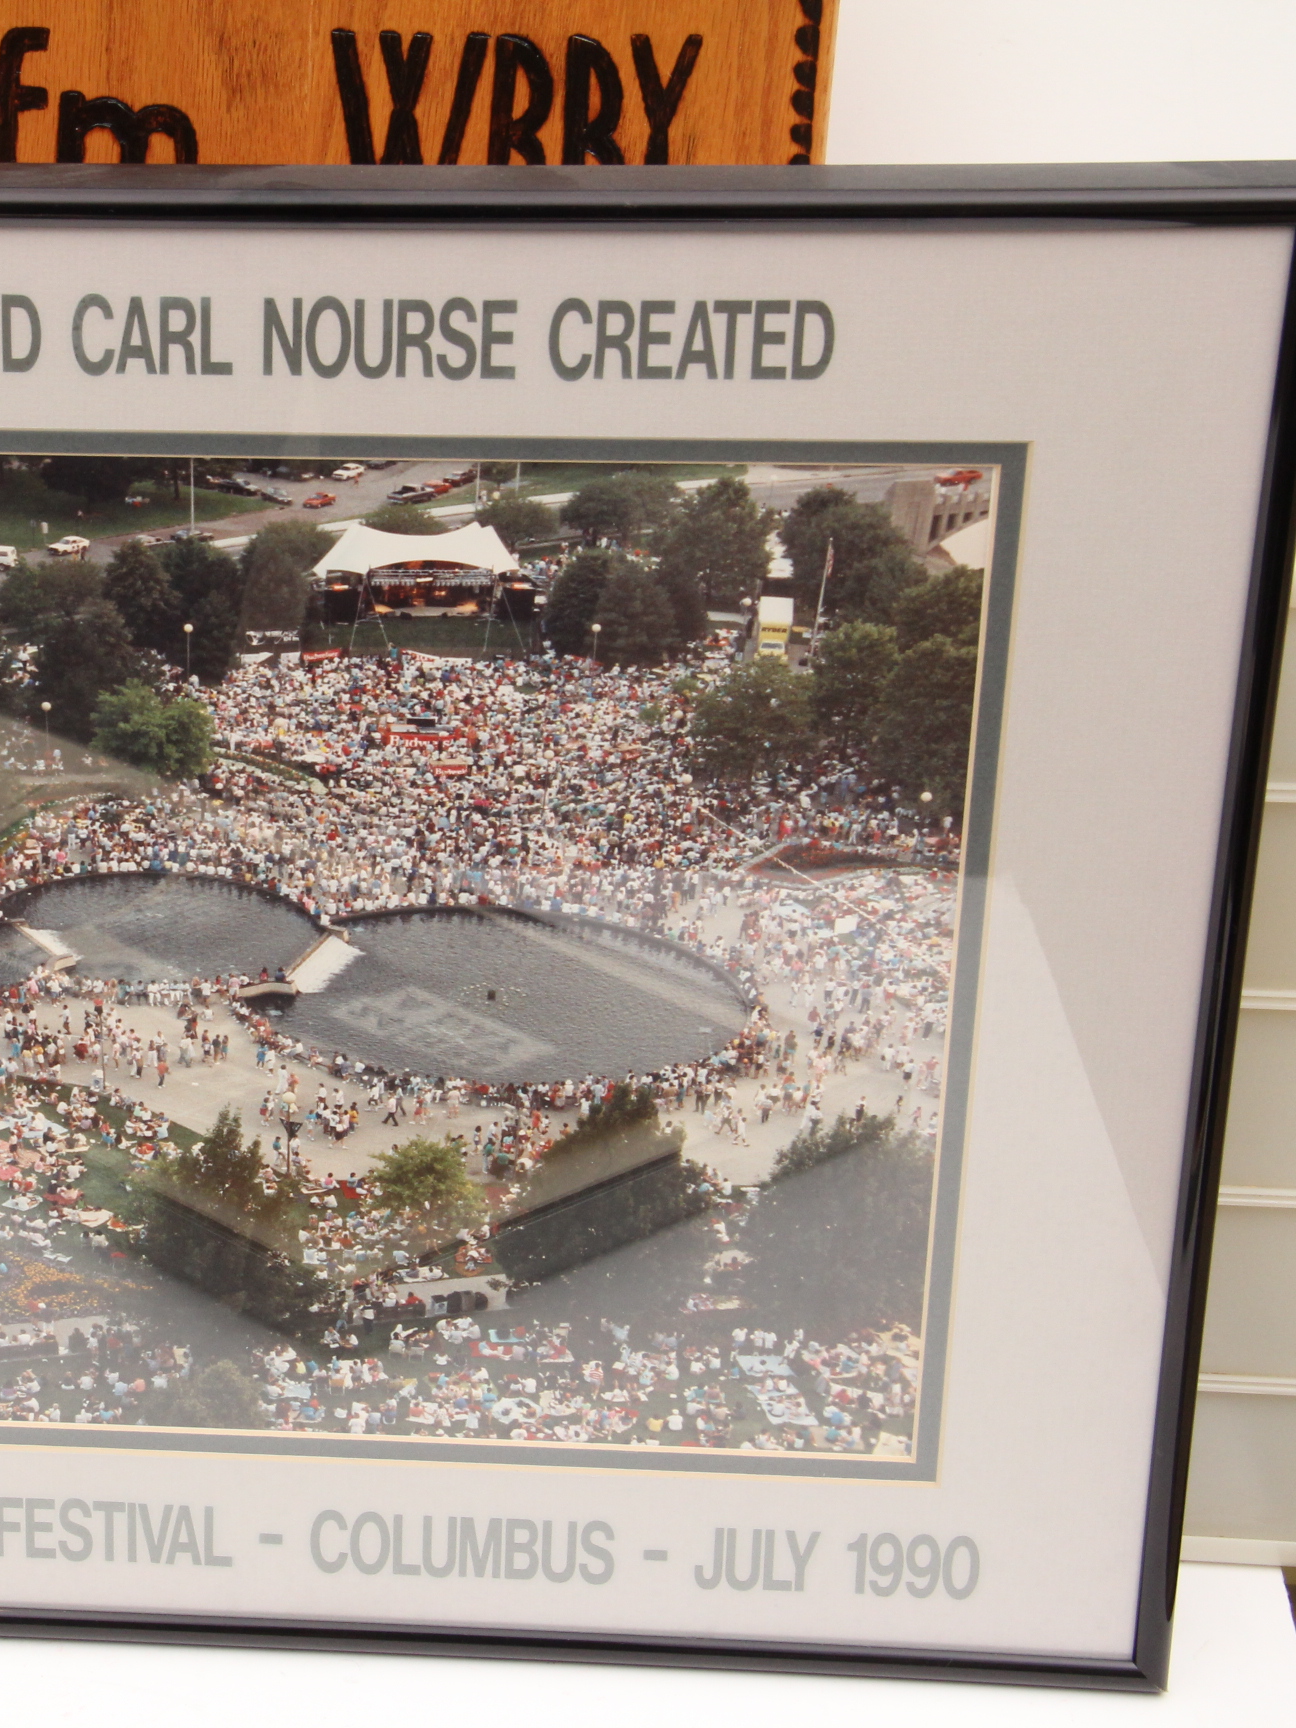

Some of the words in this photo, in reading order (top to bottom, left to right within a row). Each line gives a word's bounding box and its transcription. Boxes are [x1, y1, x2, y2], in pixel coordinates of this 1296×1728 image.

[331, 27, 704, 165] WBBY
[71, 293, 234, 377] CARL
[262, 295, 518, 382] NOURSE
[548, 297, 836, 382] CREATED
[309, 1508, 616, 1586] COLUMBUS
[693, 1526, 822, 1593] JULY
[846, 1531, 981, 1601] 1990
